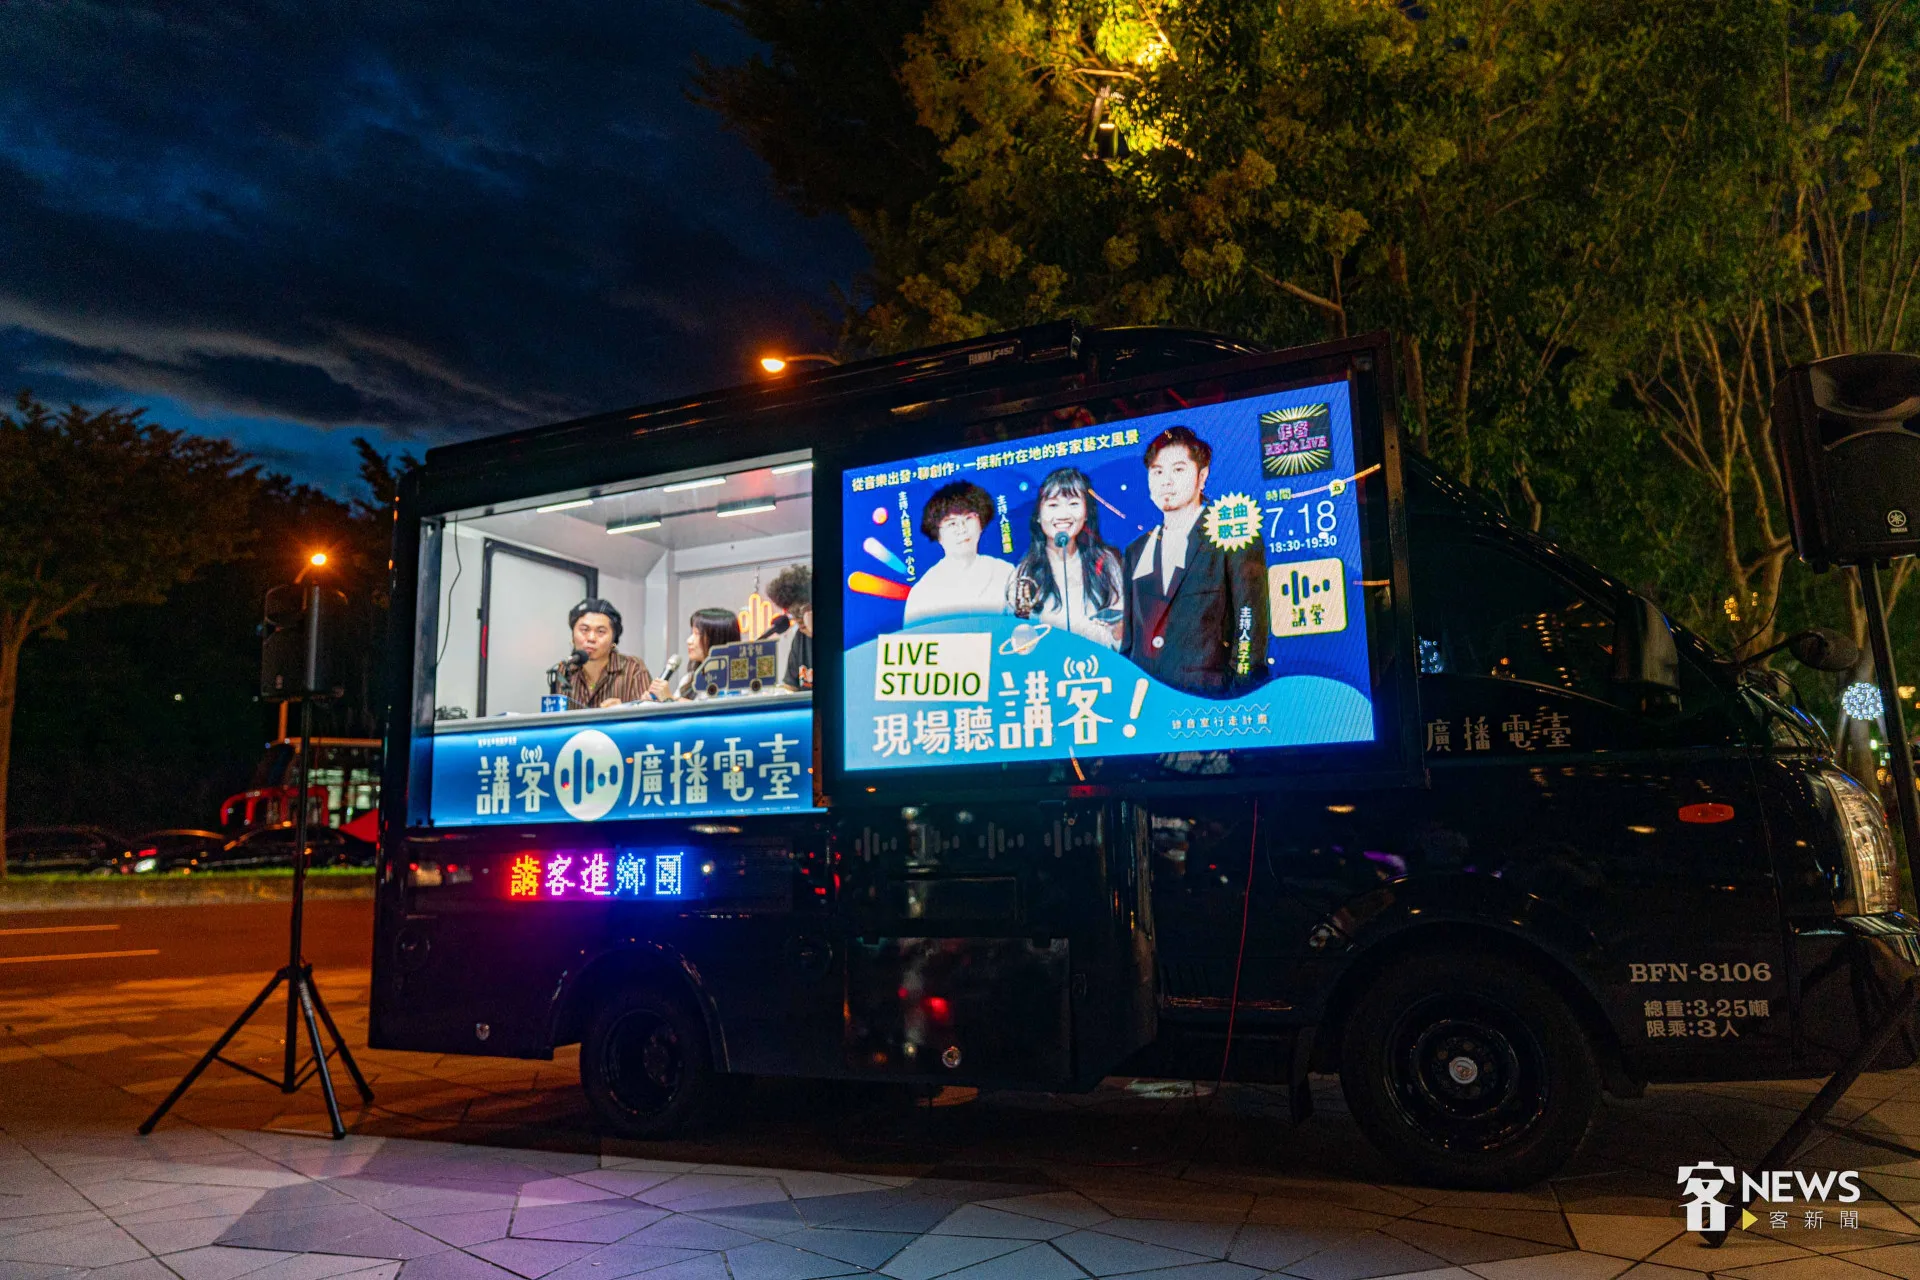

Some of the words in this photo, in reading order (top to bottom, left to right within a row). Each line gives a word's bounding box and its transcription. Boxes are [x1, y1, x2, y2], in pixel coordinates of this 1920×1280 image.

[1265, 488, 1292, 501] 時間
[1217, 503, 1248, 521] 金曲
[1265, 500, 1337, 538] 7.18
[1217, 522, 1250, 540] 歌王
[1269, 535, 1337, 553] 18:30-19:30
[884, 642, 939, 666] LIVE
[881, 672, 981, 696] STUDIO
[1426, 712, 1571, 752] 廣播電臺
[476, 745, 550, 816] 講客
[629, 733, 800, 807] 廣播電臺
[1629, 963, 1772, 982] BFN-8106
[1646, 1020, 1739, 1037] 限乘:3人
